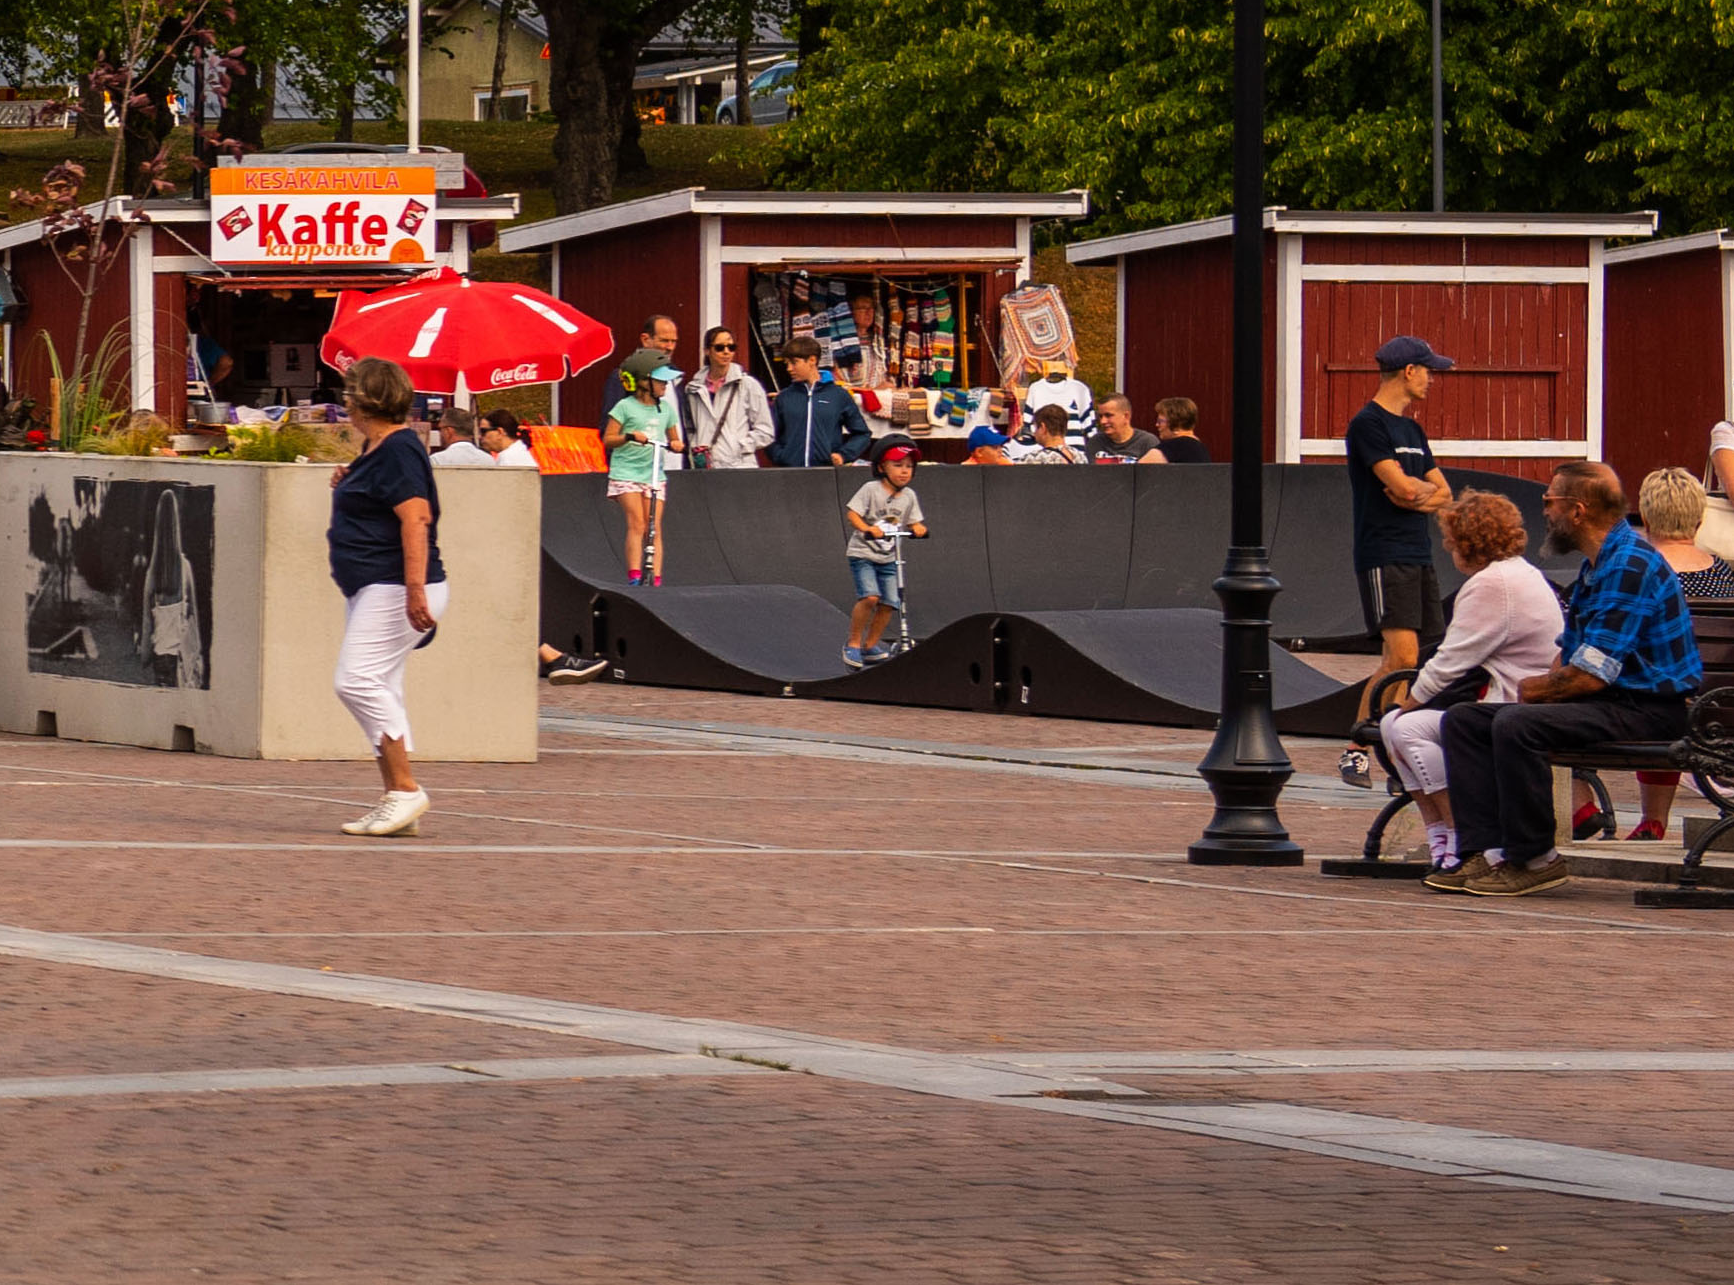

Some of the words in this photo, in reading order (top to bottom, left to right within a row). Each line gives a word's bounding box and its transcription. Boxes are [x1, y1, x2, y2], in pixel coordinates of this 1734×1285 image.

[244, 168, 401, 191] KESÄKAHVILA
[258, 200, 388, 247] Kaffe
[265, 234, 380, 264] kupponen
[490, 363, 539, 386] Coca-Cola
